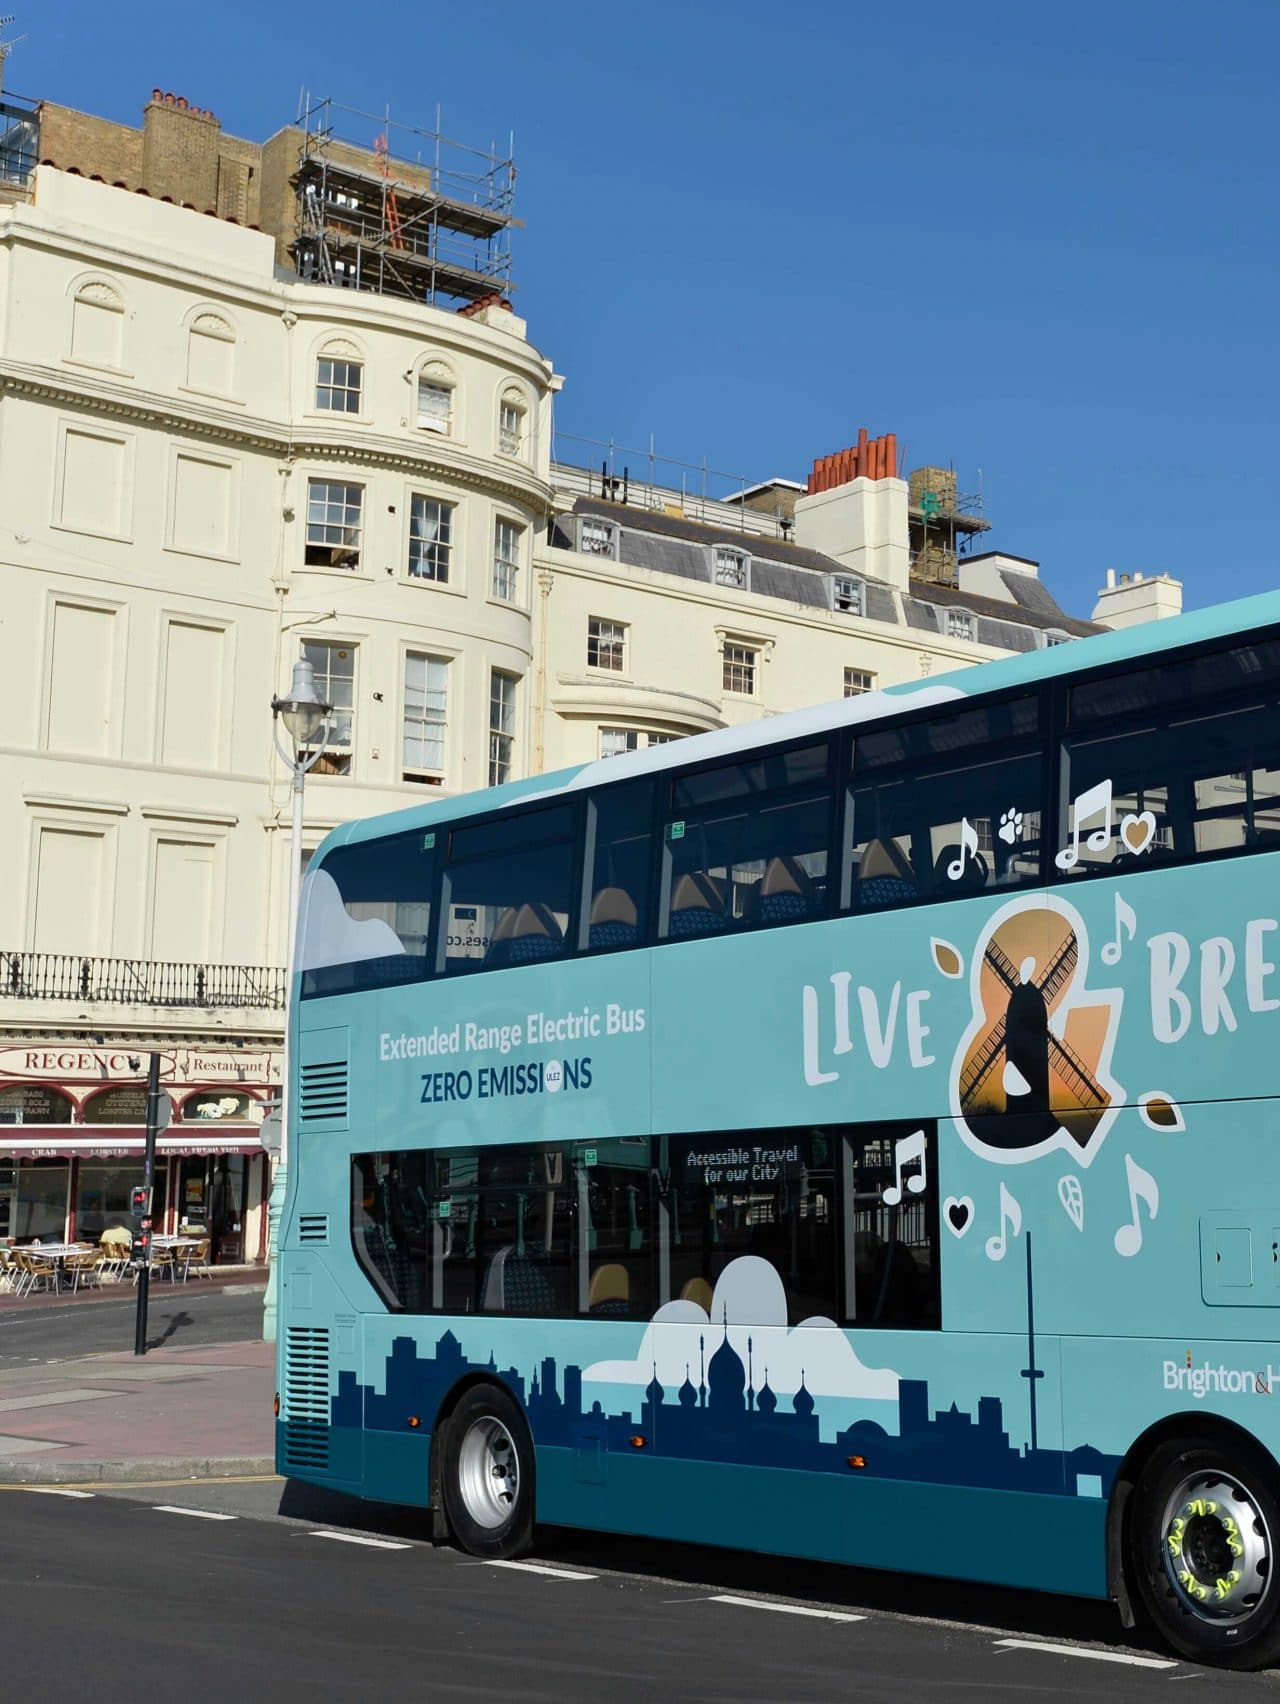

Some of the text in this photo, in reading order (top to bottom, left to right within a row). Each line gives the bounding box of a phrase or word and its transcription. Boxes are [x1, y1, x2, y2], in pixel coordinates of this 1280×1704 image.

[379, 1003, 646, 1061] Extended Range Electric Bus
[802, 971, 936, 1086] LIVE
[949, 892, 1128, 1169] &
[194, 1058, 264, 1072] Restaurant
[420, 1070, 473, 1104] ZERO
[32, 1148, 57, 1156] CRAB
[687, 1145, 798, 1166] Accessible Travel
[704, 1164, 780, 1185] for our City
